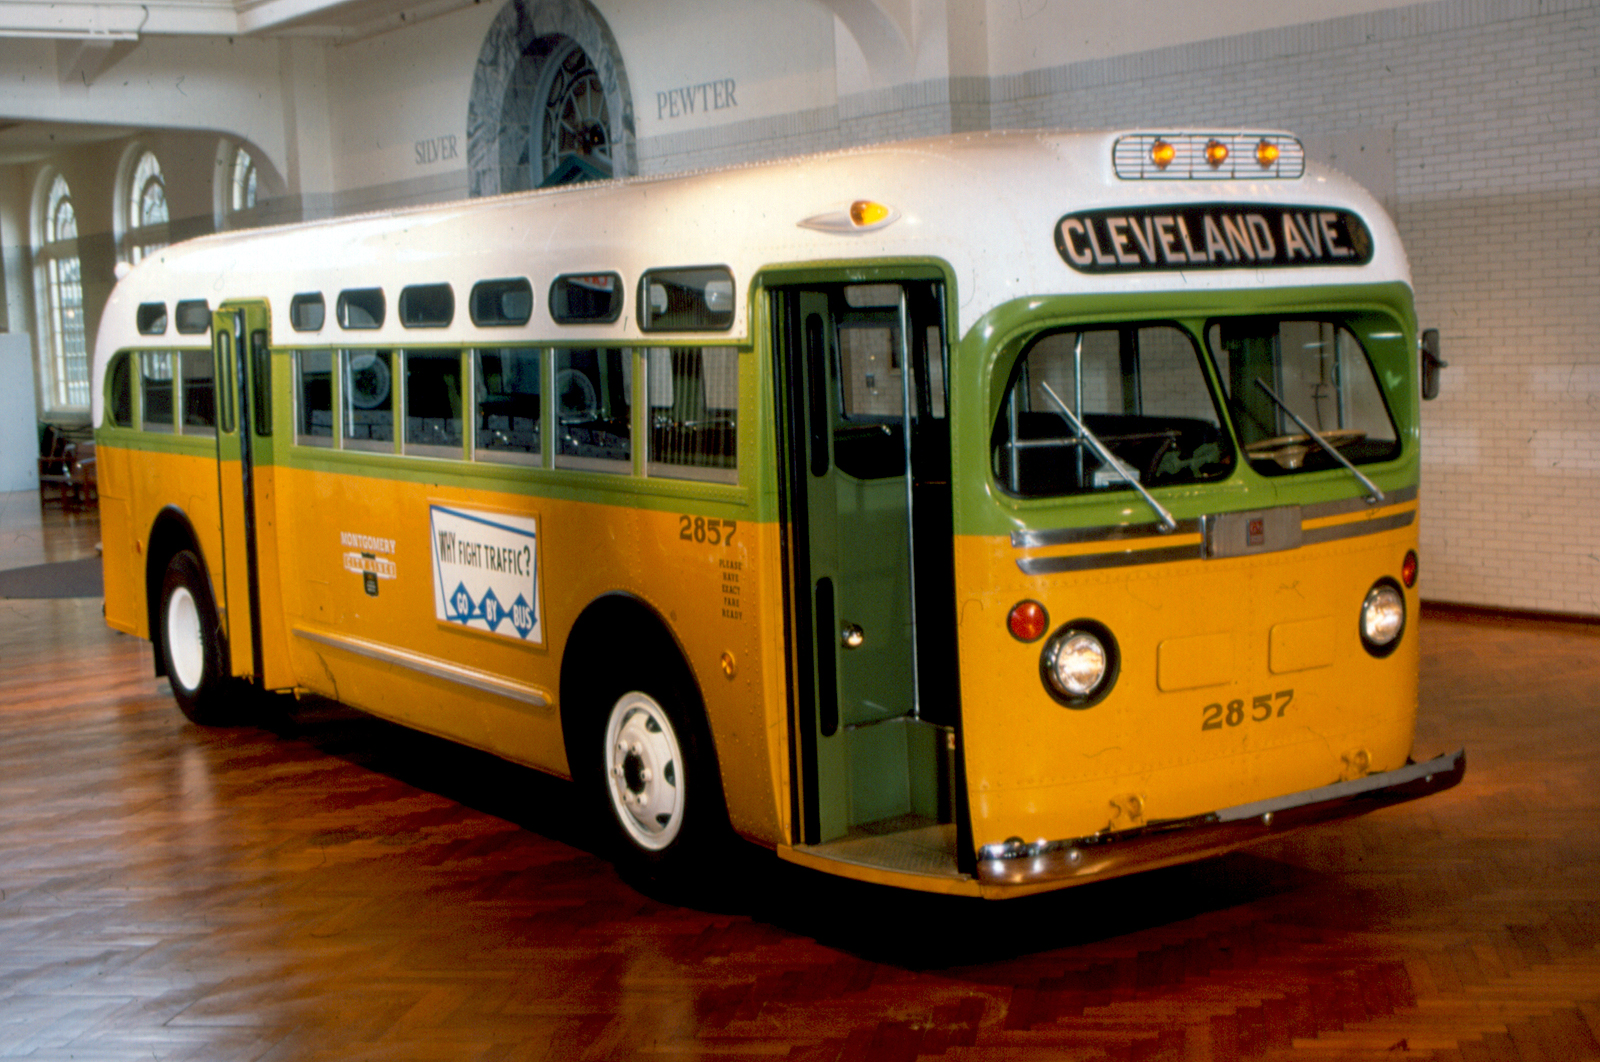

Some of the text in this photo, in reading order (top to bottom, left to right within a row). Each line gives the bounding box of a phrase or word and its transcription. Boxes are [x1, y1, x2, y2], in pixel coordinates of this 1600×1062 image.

[657, 78, 738, 120] PEWTER
[415, 134, 458, 165] SILVER
[1061, 213, 1356, 265] CLEVELAND AVE.
[340, 531, 396, 555] MONTGOMERY
[679, 515, 737, 546] 2857
[438, 530, 531, 577] WHY FIGHT TRAFFIC?
[719, 559, 742, 570] PLEASE
[722, 584, 740, 595] EXACT
[456, 593, 532, 629] GO BY BUS
[722, 609, 742, 620] READY
[1201, 689, 1294, 731] 2857
